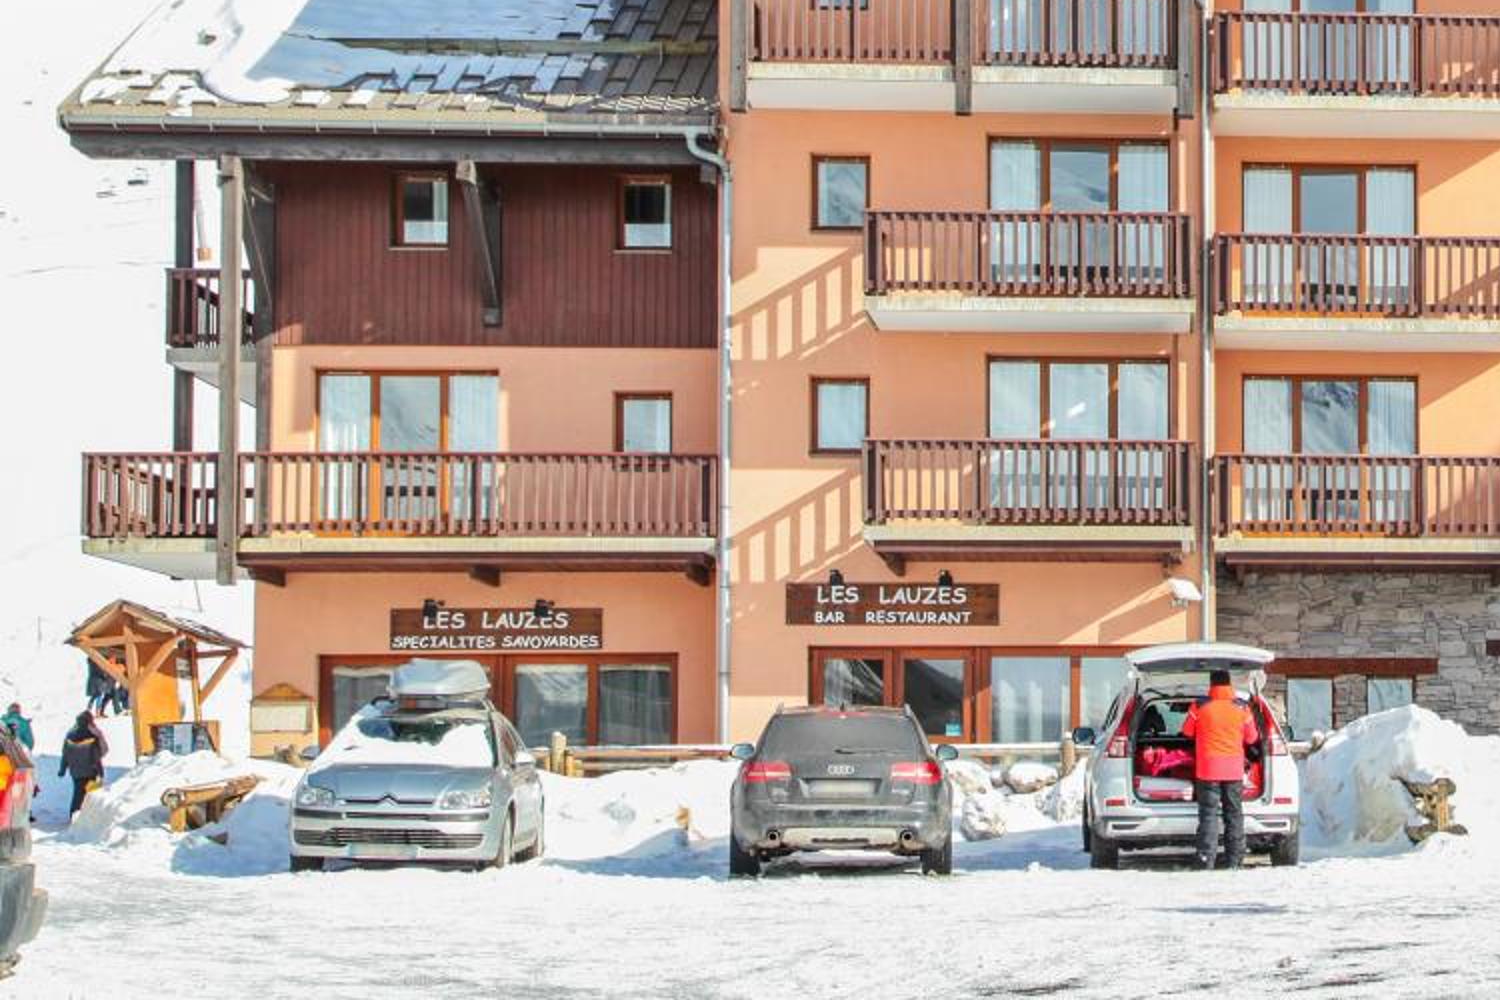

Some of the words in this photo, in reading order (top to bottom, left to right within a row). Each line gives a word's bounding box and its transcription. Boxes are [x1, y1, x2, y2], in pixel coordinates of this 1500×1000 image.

[817, 585, 859, 604] LES
[879, 585, 967, 604] LAUZES
[481, 610, 569, 629] LAUZES
[814, 611, 845, 623] BAR
[865, 611, 972, 624] RESTAURANT
[392, 635, 496, 649] SPECIALITES
[501, 635, 599, 649] SAVOYARDES
